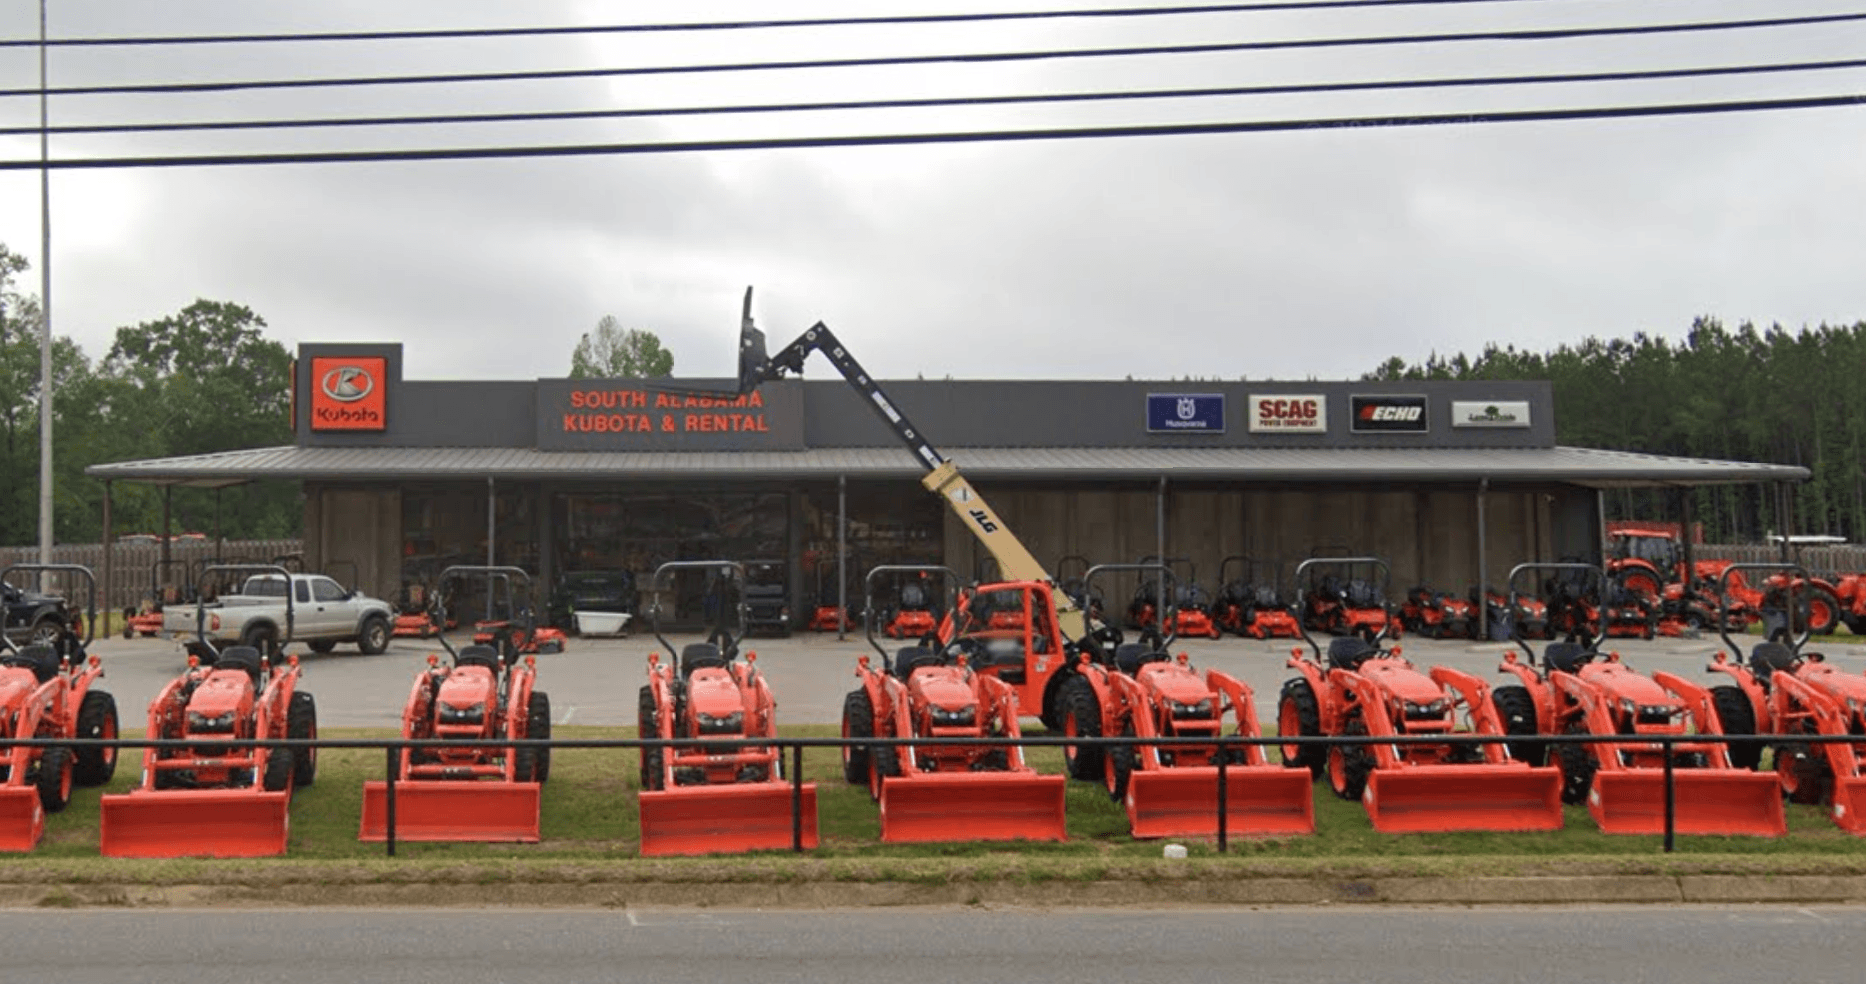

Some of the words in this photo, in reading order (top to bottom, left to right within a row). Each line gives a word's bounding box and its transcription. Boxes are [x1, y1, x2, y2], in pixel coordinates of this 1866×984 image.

[570, 390, 648, 409] SOUTH
[316, 406, 379, 422] Kubota
[1258, 400, 1317, 419] SCAG
[1372, 406, 1422, 421] ECHO
[563, 413, 652, 433] KUBOTA
[661, 413, 676, 433] &
[684, 413, 769, 433] RENTAL
[969, 510, 998, 533] JLG
